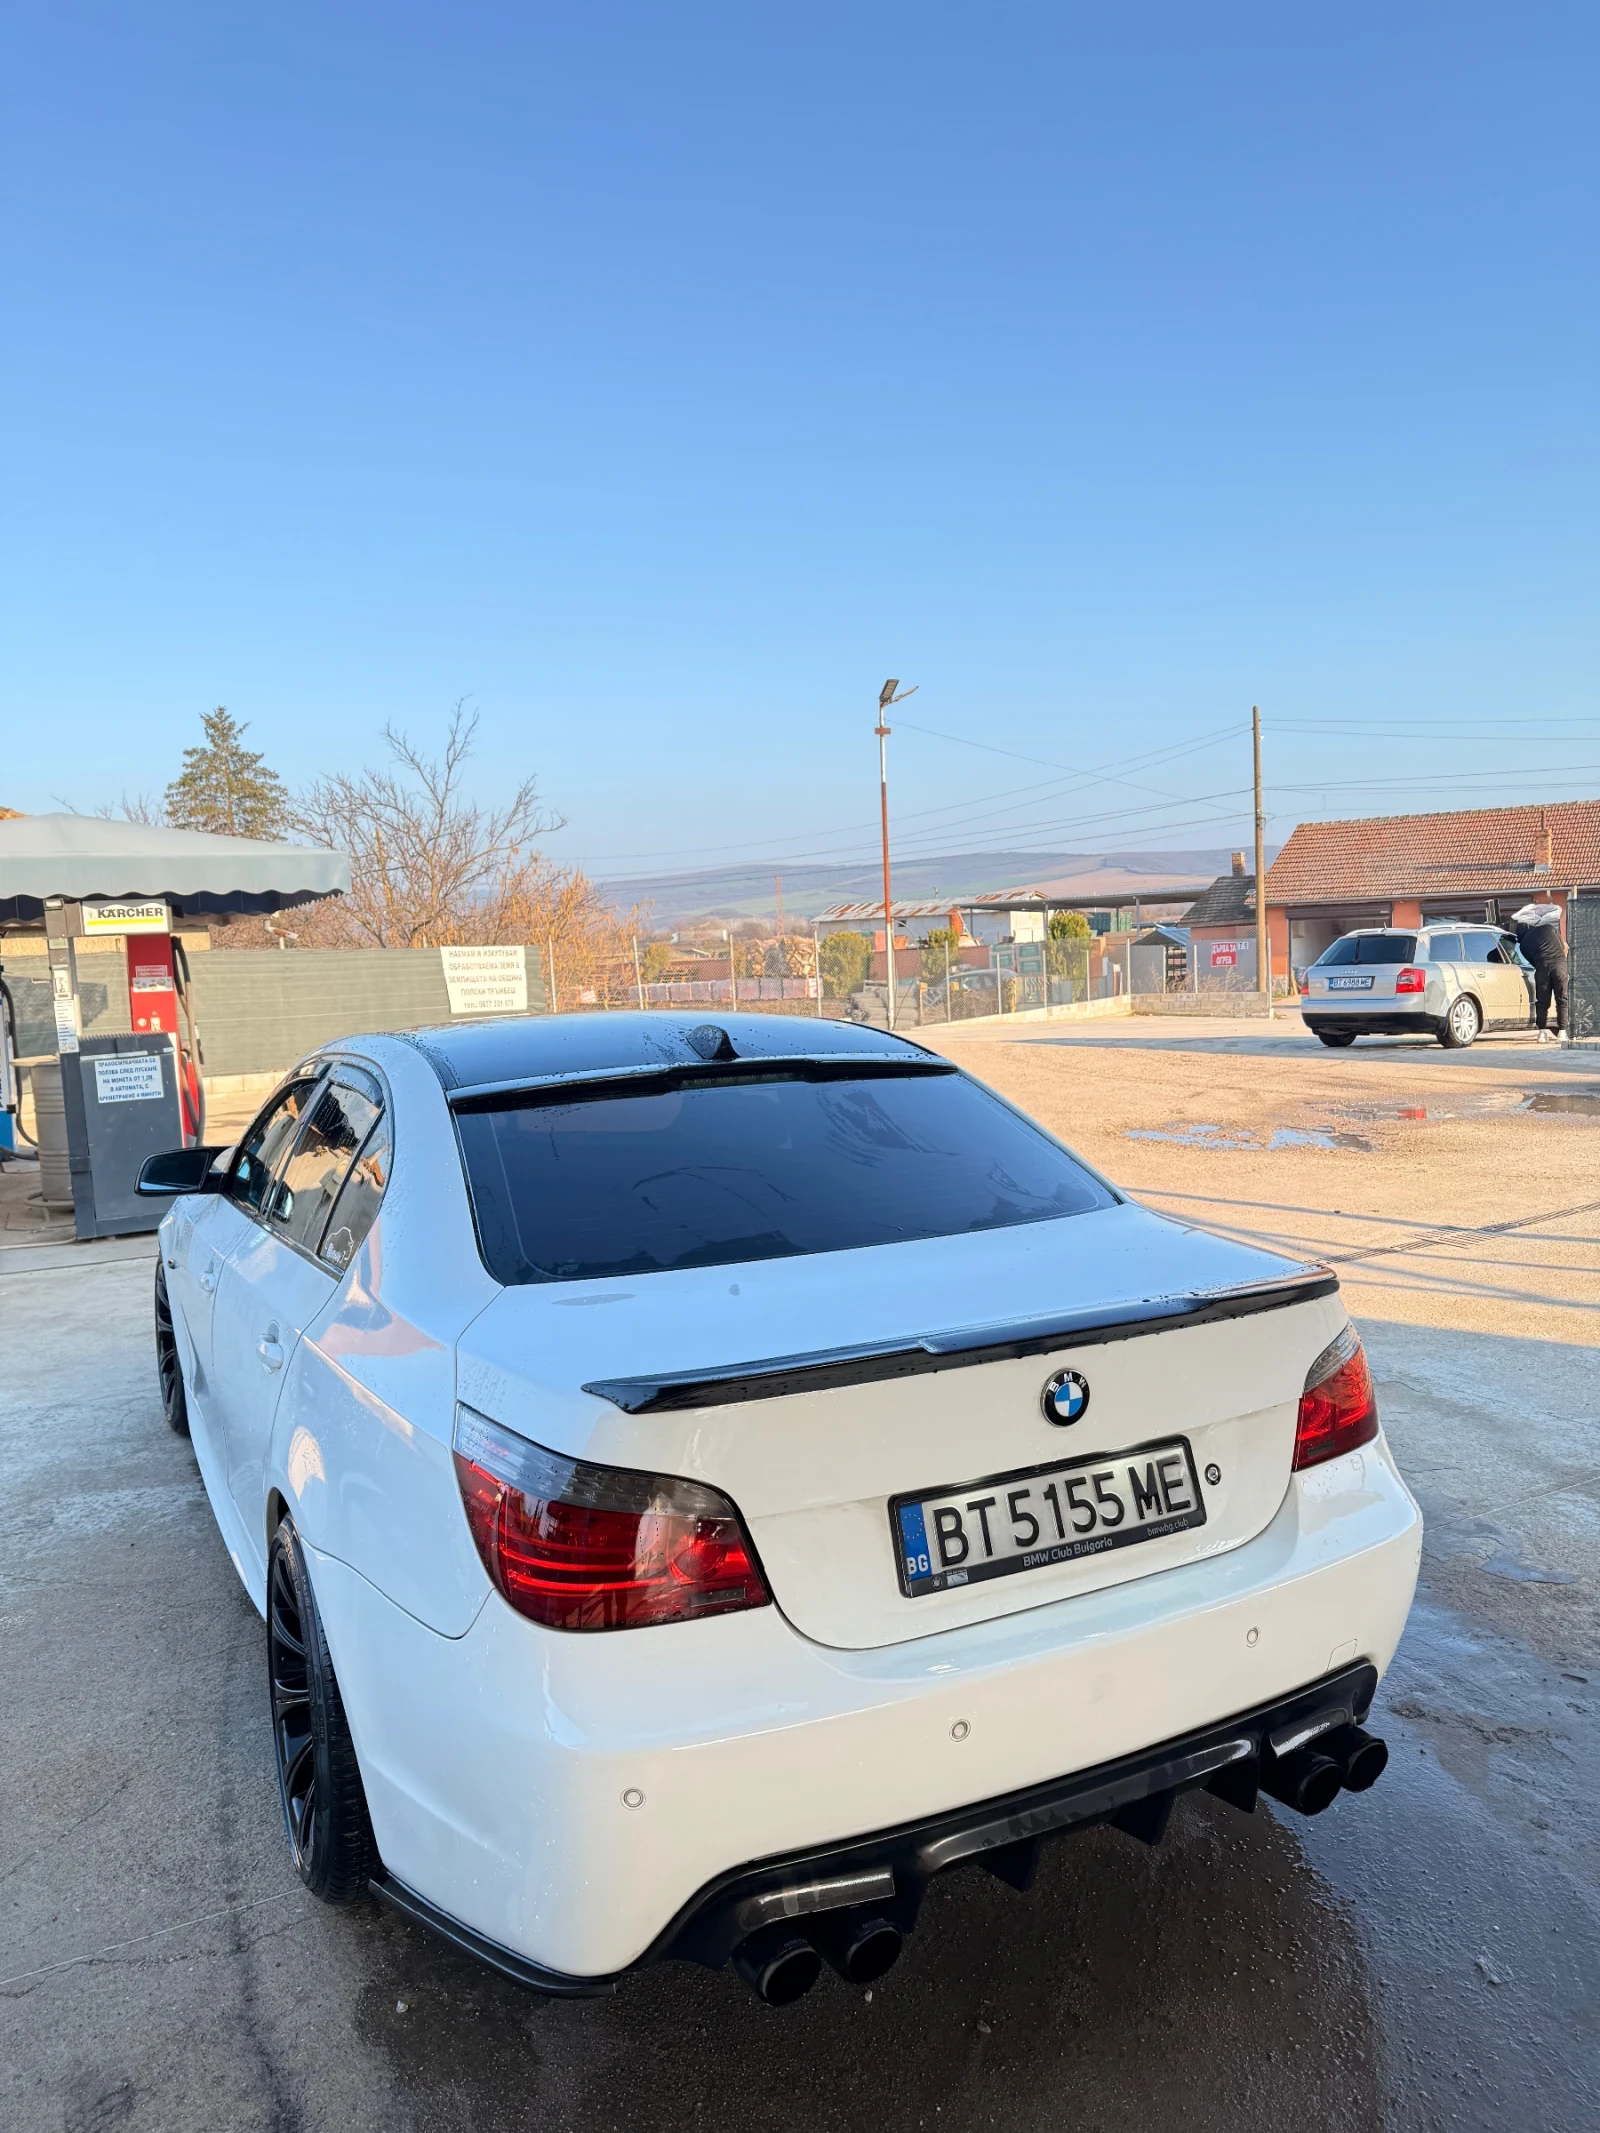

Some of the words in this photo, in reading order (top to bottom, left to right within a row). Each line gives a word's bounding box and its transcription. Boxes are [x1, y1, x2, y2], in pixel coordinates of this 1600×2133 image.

[98, 908, 164, 918] KÄRCHER
[1048, 1372, 1086, 1392] BMW
[933, 1496, 996, 1567] BT
[1007, 1470, 1125, 1547] 5155
[1127, 1454, 1191, 1521] ME
[1147, 1518, 1188, 1536] bmwbg.club
[1023, 1551, 1049, 1567] BMW
[1051, 1546, 1072, 1560] Club
[1074, 1537, 1113, 1555] Bulgaria
[906, 1553, 929, 1575] BG
